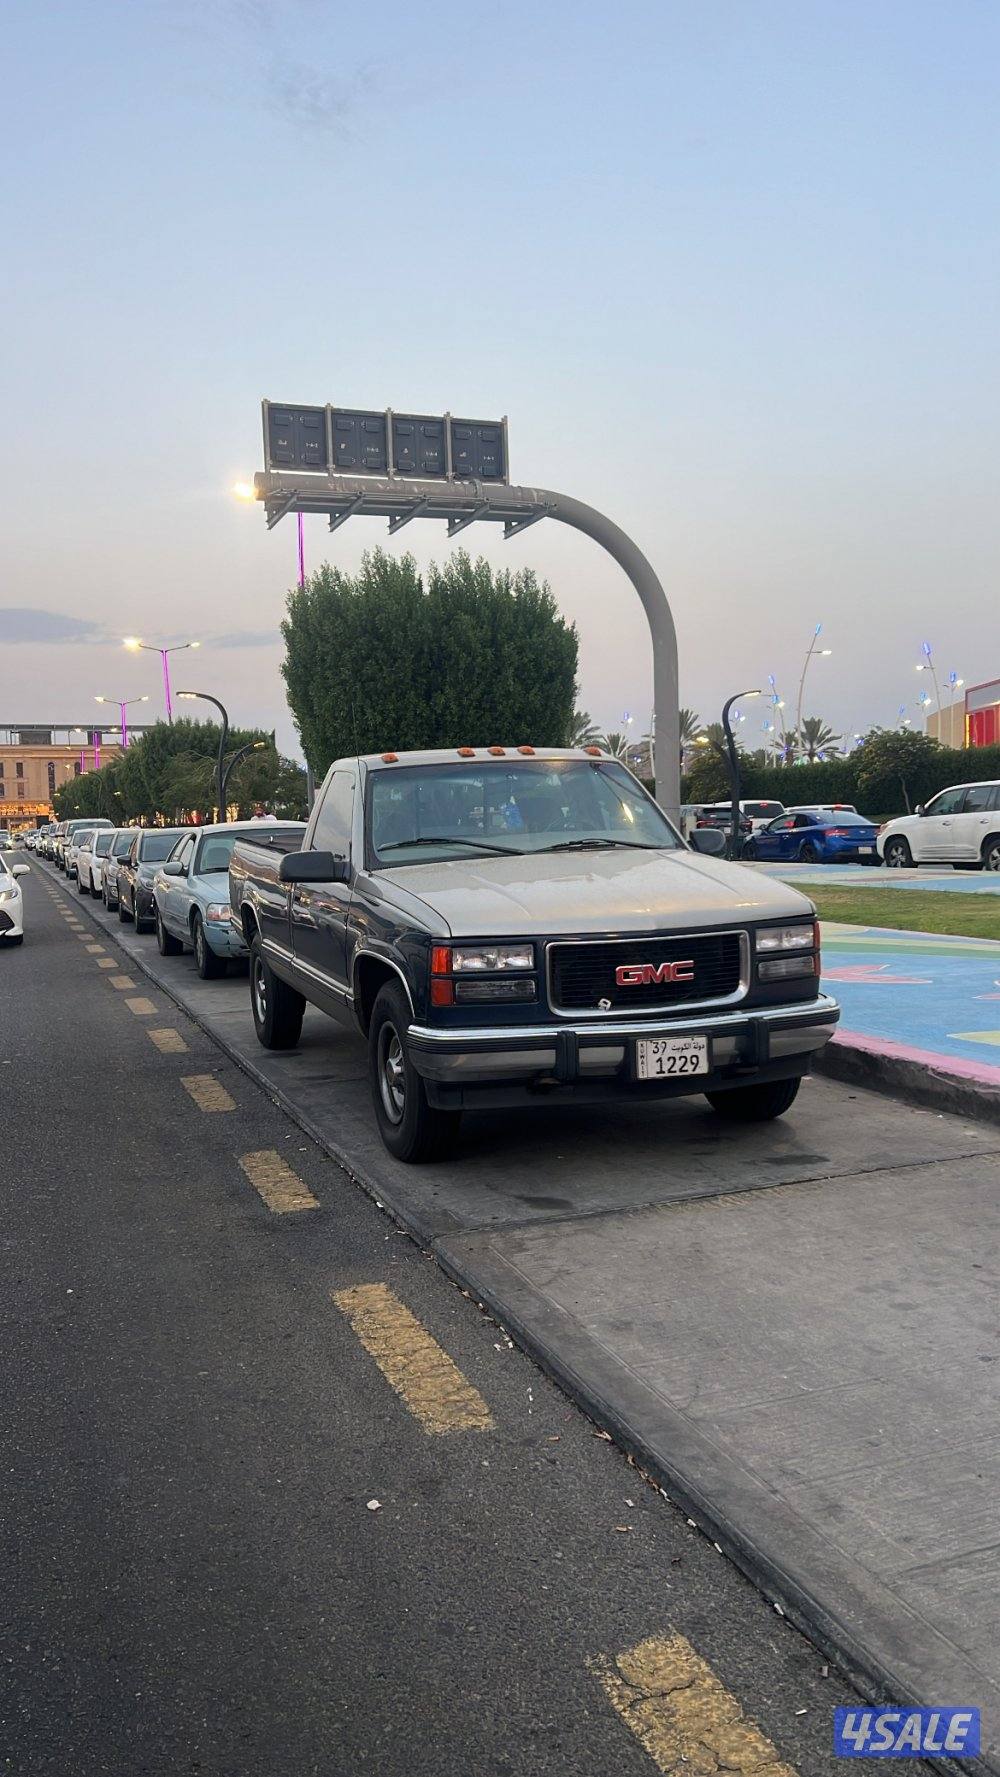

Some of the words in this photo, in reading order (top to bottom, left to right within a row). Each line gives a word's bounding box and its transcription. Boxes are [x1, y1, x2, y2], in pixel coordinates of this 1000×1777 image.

[615, 960, 694, 986] GMC
[671, 1043, 691, 1052] الكويت
[692, 1041, 705, 1051] دولة
[656, 1054, 700, 1075] 1229
